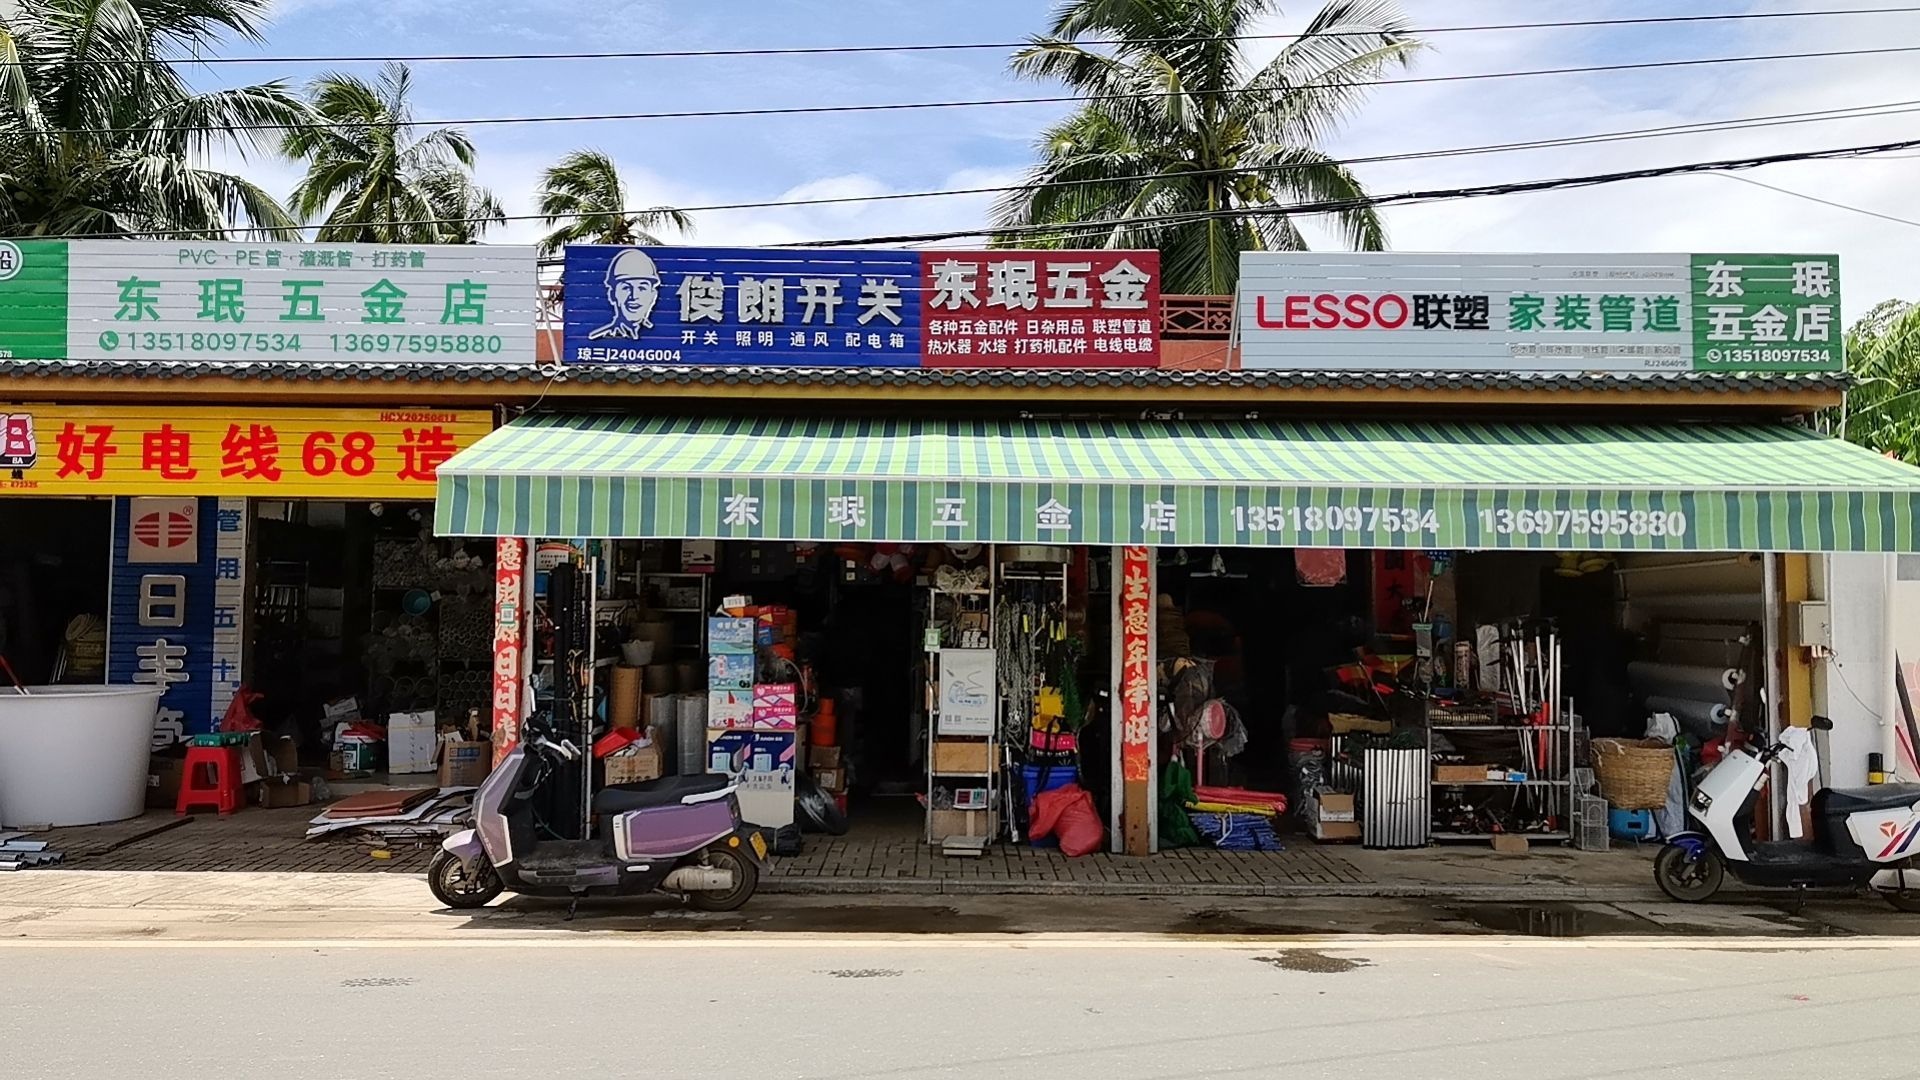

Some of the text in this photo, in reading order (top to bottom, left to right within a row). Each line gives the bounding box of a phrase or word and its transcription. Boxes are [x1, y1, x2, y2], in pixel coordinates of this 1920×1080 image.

[114, 275, 488, 325] 东珉五金店
[676, 276, 903, 326] 俊朗开关
[927, 258, 1152, 310] 东珉五金
[928, 318, 1153, 335] 各种五金配件 日杂用品 联塑管道
[1508, 294, 1682, 332] 家装管道
[1706, 304, 1831, 342] 五金店
[128, 332, 501, 354] 13518097534 13697595880
[577, 347, 681, 362] 琼三J2404G004
[681, 330, 905, 349] 开关 照明 通风 配电箱
[927, 337, 1153, 355] 热水器 水塔 打药机配件 电线电缆
[1723, 350, 1830, 362] 13518097534
[55, 421, 458, 482] 好电线68造
[723, 494, 1687, 538] 东珉五金店 13518097534 13697595880
[211, 508, 243, 736] 管用五十
